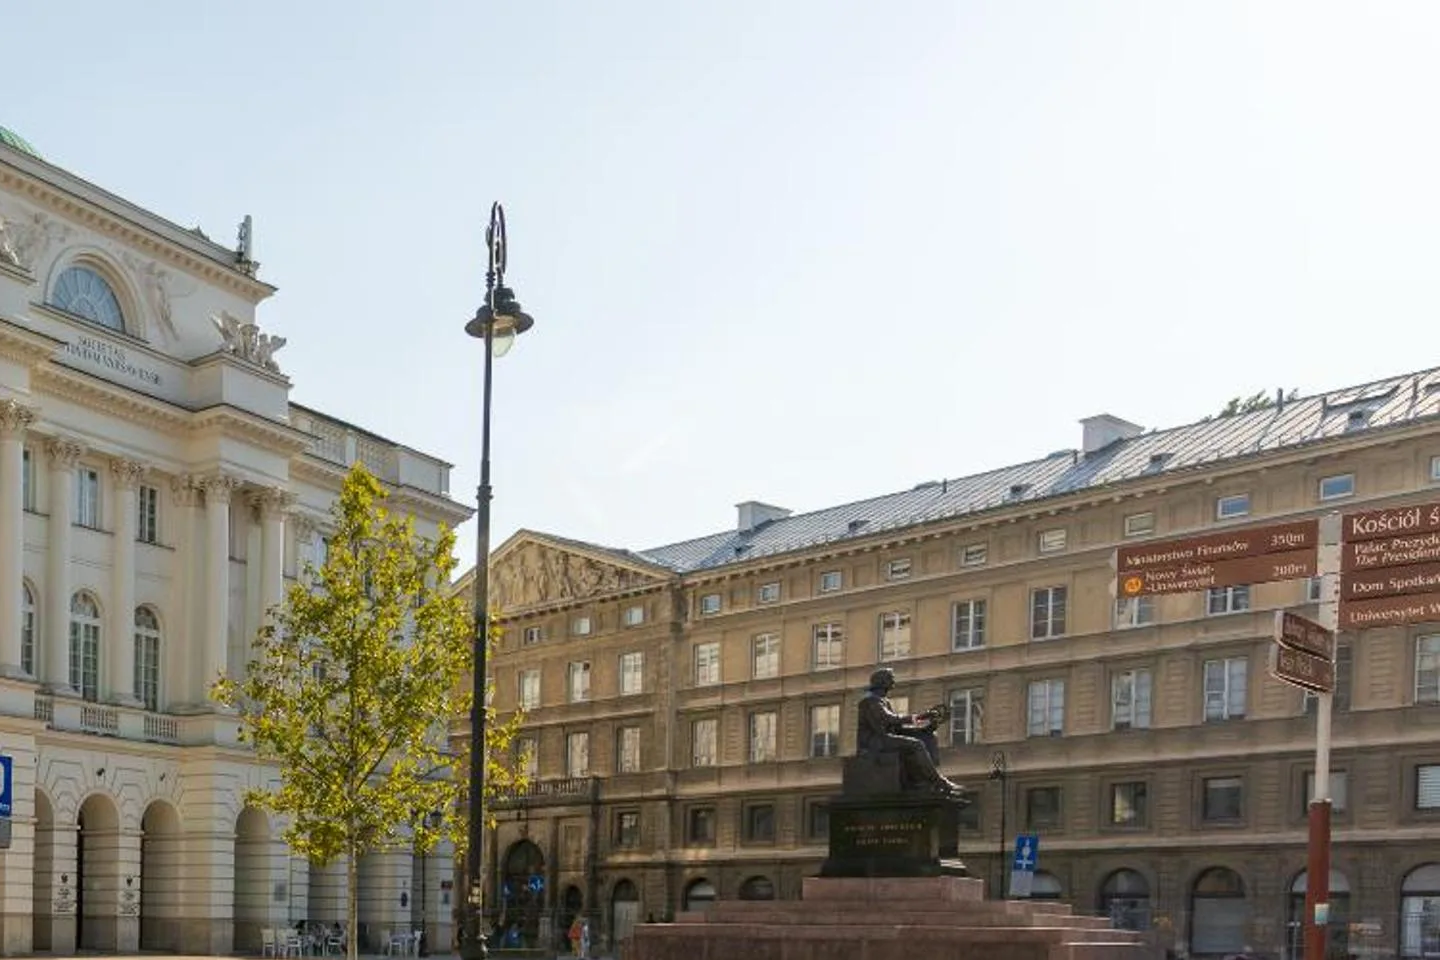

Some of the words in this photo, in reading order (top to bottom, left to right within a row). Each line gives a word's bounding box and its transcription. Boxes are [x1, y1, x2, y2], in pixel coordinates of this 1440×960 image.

[1352, 508, 1421, 535] Kościół
[1352, 581, 1384, 593] Dom
[1350, 606, 1425, 623] Uniwersytet
